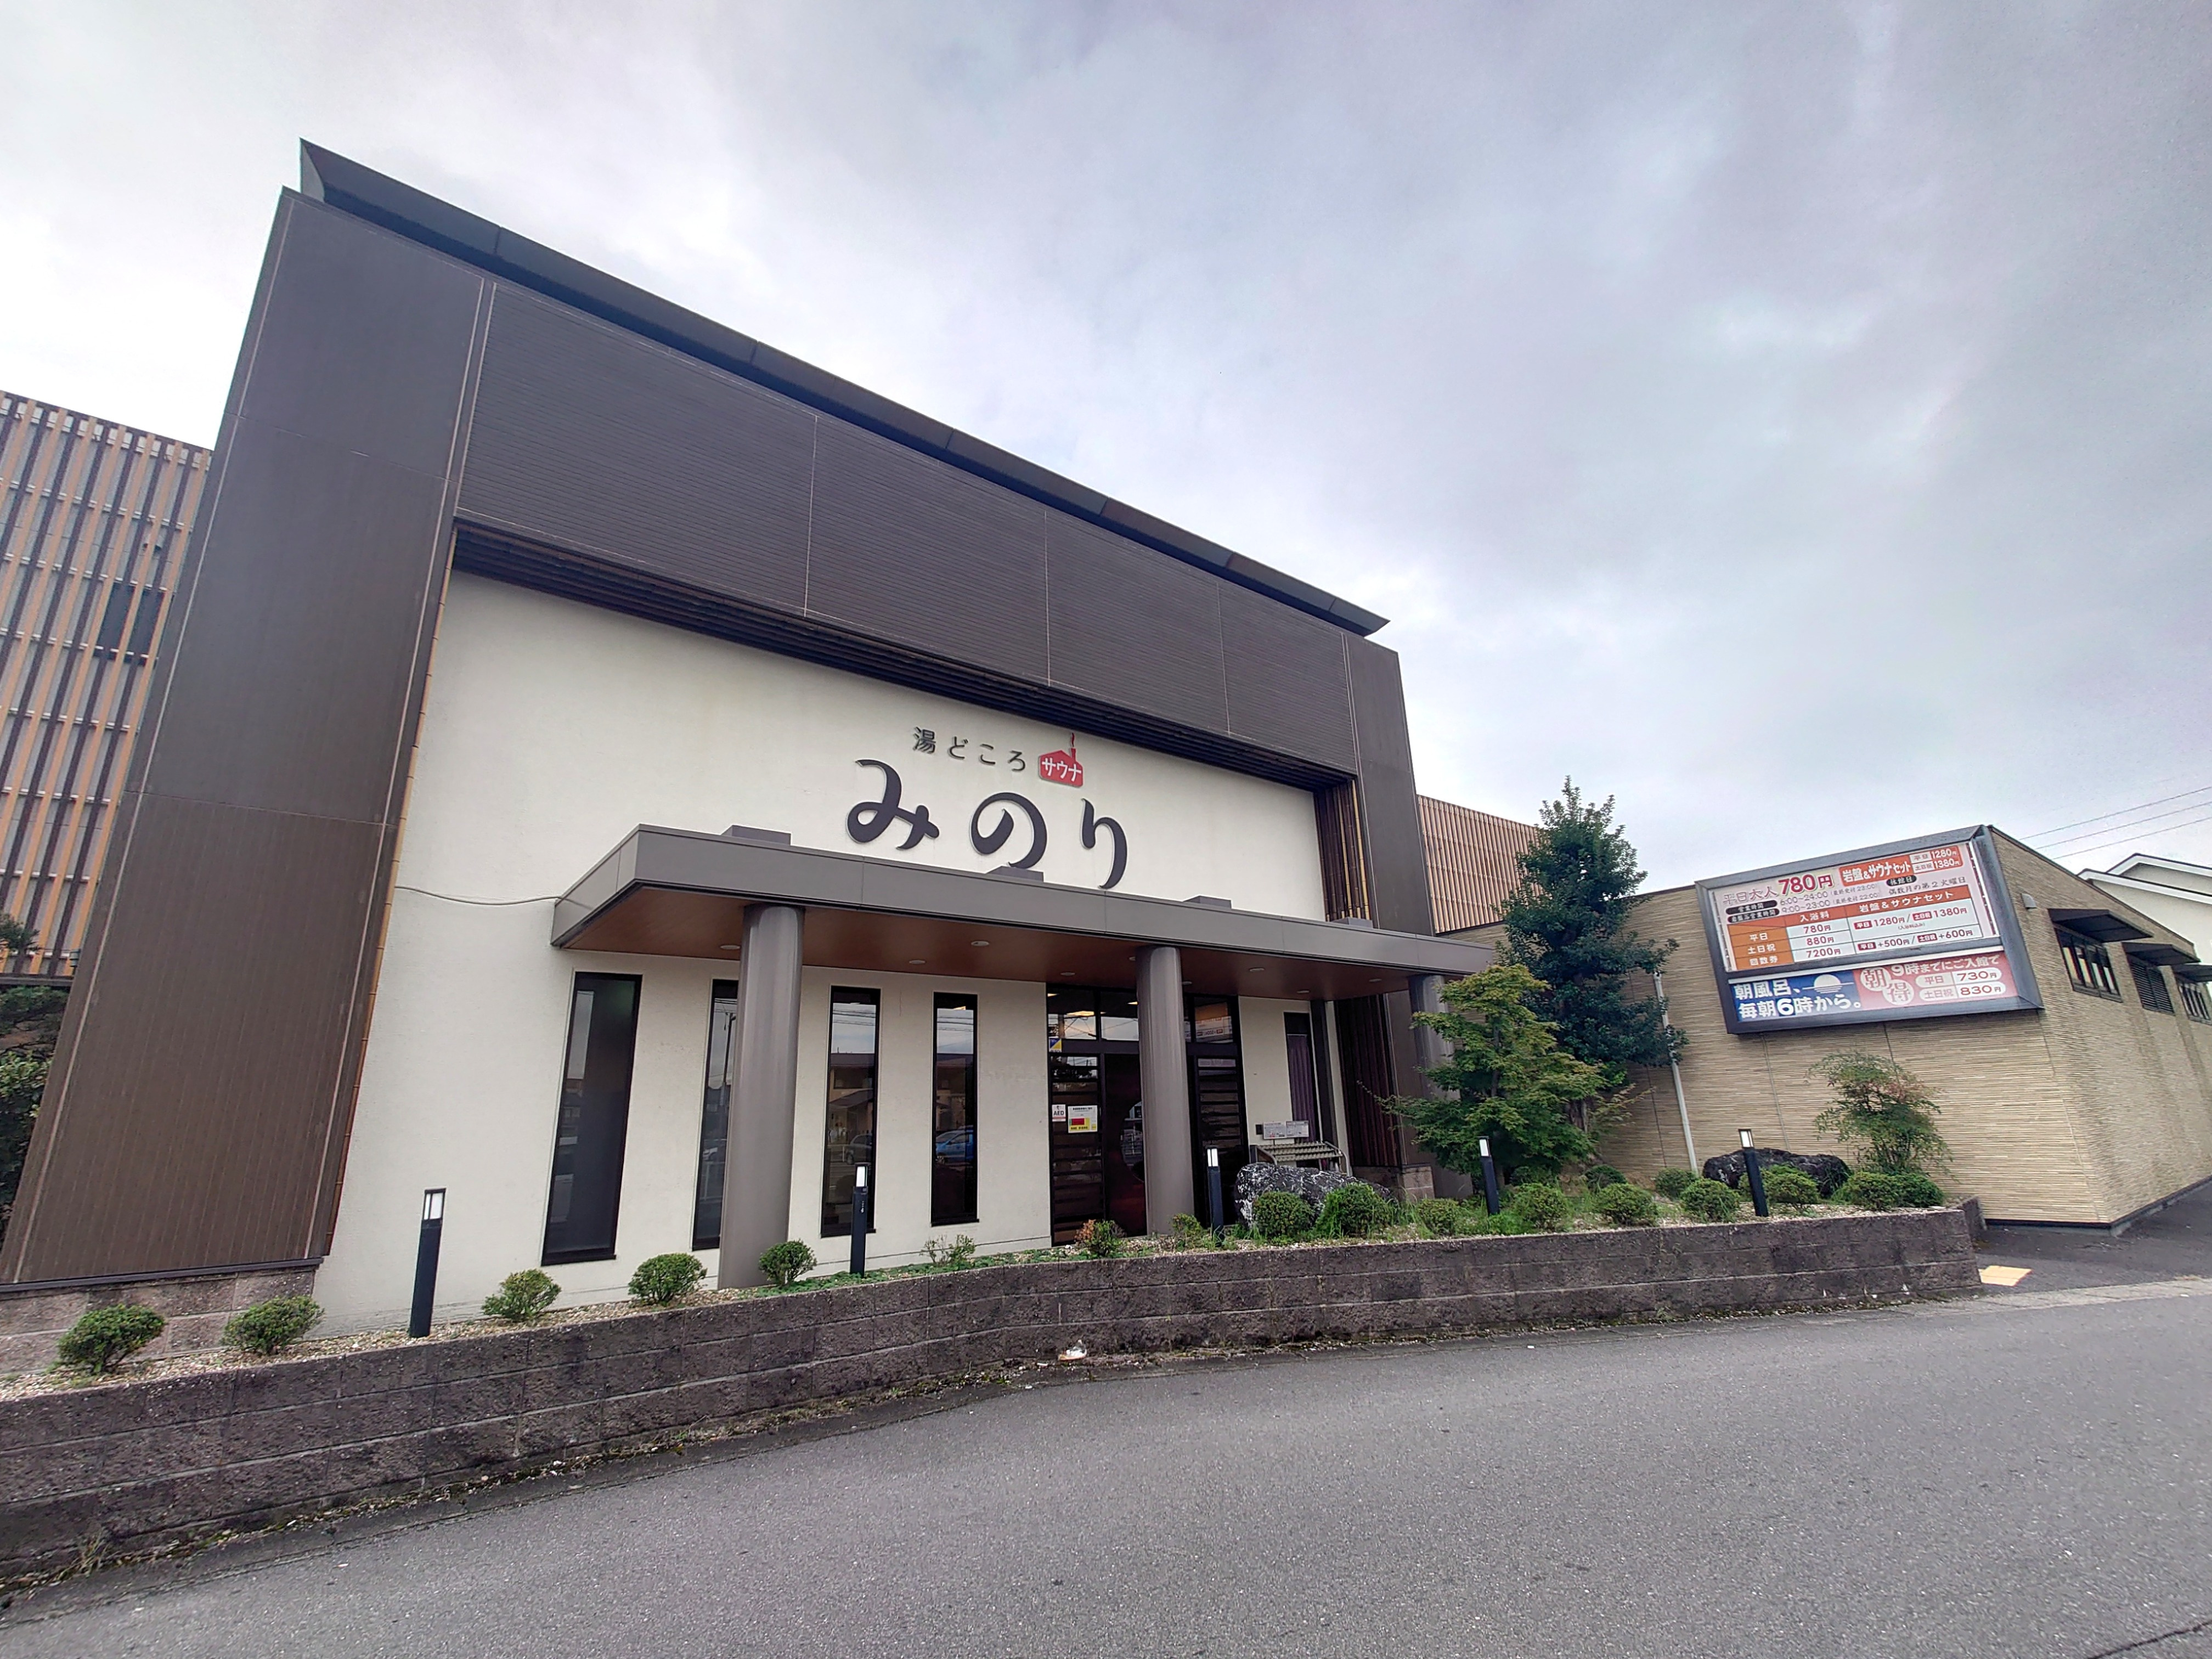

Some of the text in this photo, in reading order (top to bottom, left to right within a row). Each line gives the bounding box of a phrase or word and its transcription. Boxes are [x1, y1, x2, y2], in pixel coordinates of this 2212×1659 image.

[913, 726, 1026, 772] 湯どころ
[1042, 757, 1082, 782] サウナ
[847, 759, 1128, 889] みのり
[1932, 849, 1957, 859] 1280円
[1934, 858, 1960, 868] 1380円
[1842, 861, 1910, 882] 岩盤&サウナセット
[1778, 874, 1833, 895] 780円
[1859, 891, 1953, 912] 岩盤&サウナセット
[1800, 911, 1829, 923] 入浴料
[1874, 917, 1905, 926] 1280円
[1934, 907, 1967, 917] 1380円
[1750, 924, 1831, 941] 平日 780円
[1878, 938, 1910, 947] +500円
[1939, 929, 1973, 939] +600円
[1748, 936, 1835, 955] 土日祝 880円
[1750, 947, 1841, 966] 回数券 7200円
[1891, 955, 2000, 977] 9時までにご入館で
[1925, 970, 1997, 985] 平日 730円
[1925, 985, 2001, 999] 土日祝 830円
[1738, 994, 1861, 1019] 毎朝6時から。
